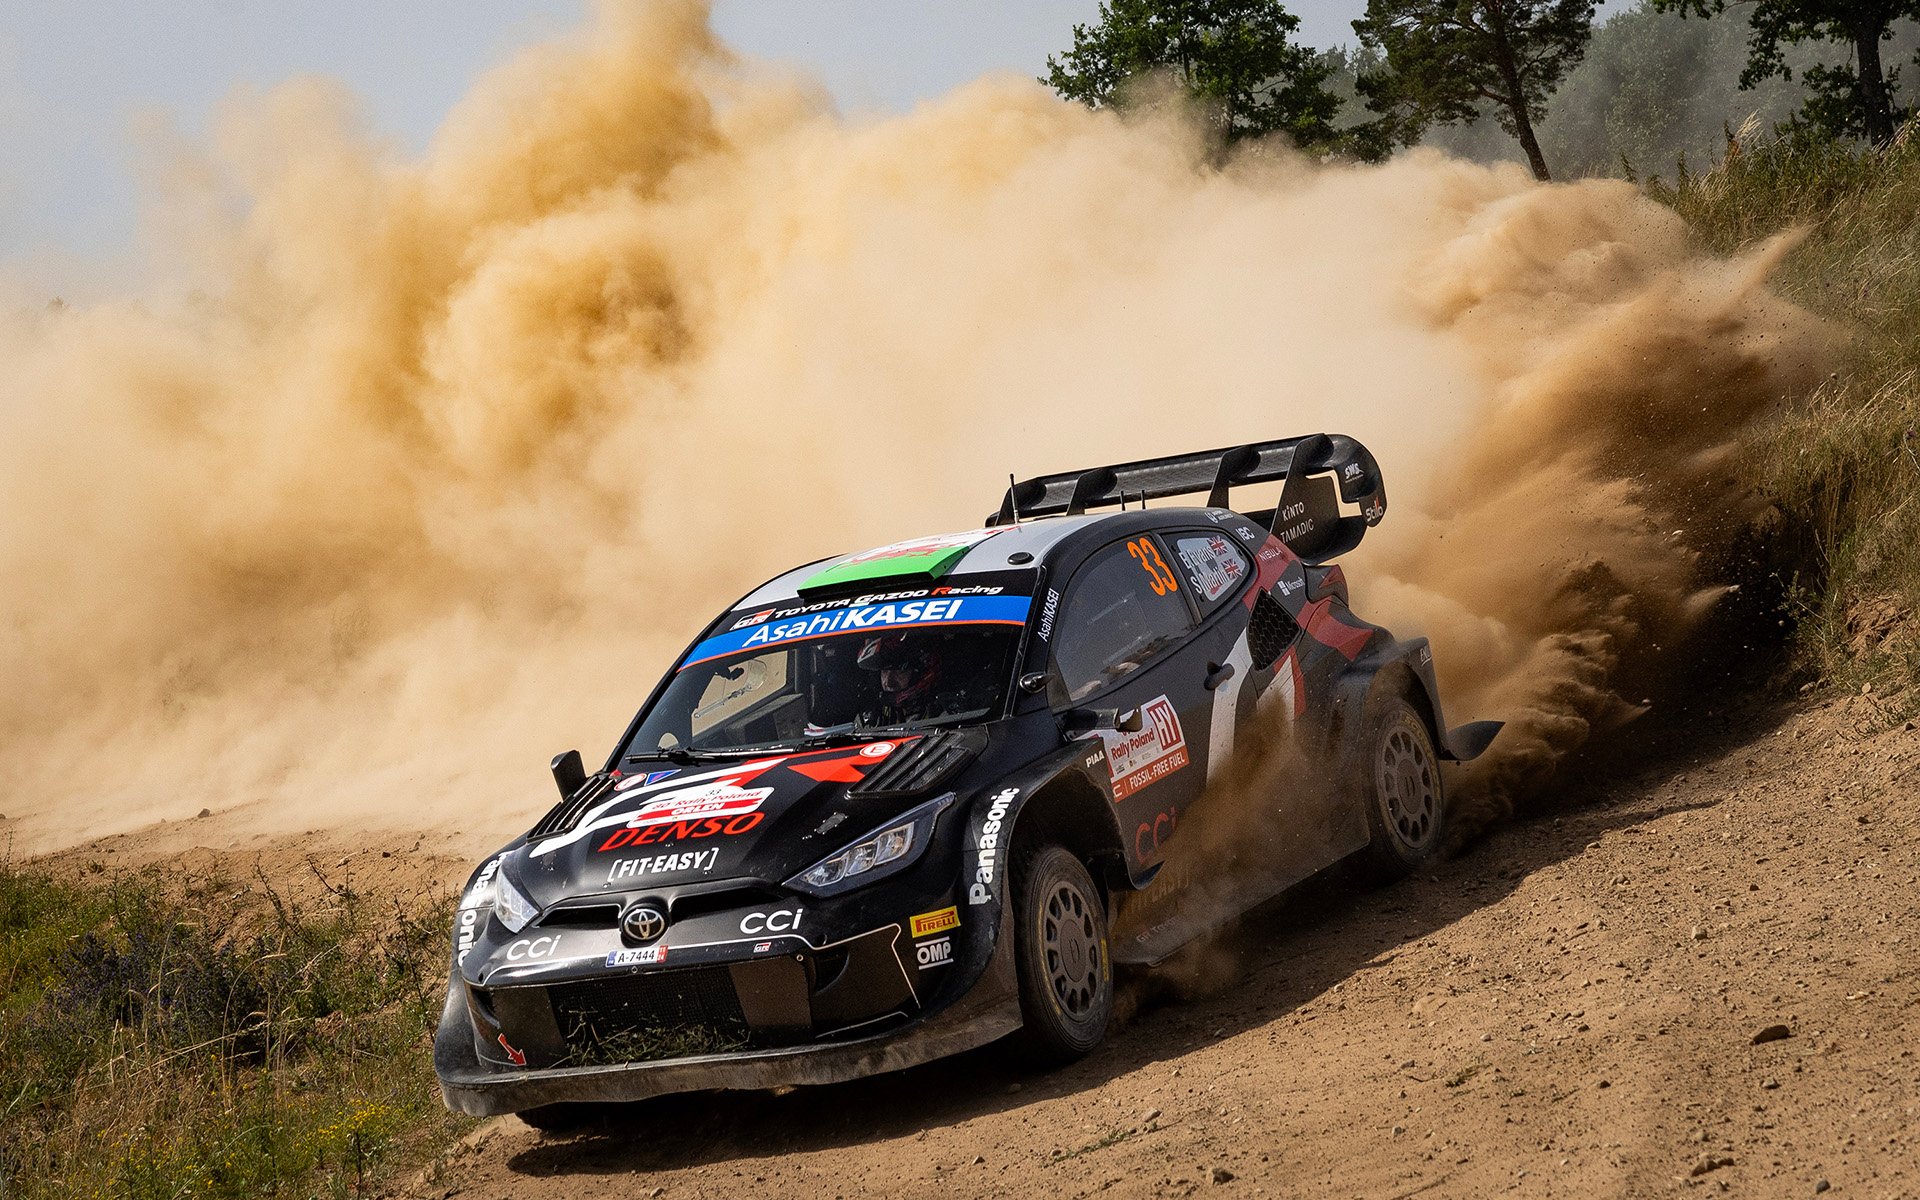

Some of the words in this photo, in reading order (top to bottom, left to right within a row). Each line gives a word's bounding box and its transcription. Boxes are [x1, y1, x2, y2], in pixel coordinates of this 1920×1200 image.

[1345, 463, 1360, 480] SWS
[1280, 519, 1315, 543] TAMADIC
[1127, 537, 1178, 596] 33
[774, 599, 850, 619] TOYOTA
[851, 589, 929, 608] GAZOO
[930, 586, 1004, 596] Racing
[1038, 588, 1060, 643] AsahiKASEI
[742, 599, 964, 648] AsahiKASEI
[1149, 704, 1177, 747] HY
[1111, 742, 1130, 761] Rally
[1129, 728, 1155, 751] Poland
[1086, 750, 1105, 768] PIAA
[1129, 760, 1169, 790] FOSSIL-FREE
[1169, 752, 1186, 769] FUEL
[705, 789, 722, 797] 33
[713, 790, 763, 801] Poland
[671, 803, 725, 816] ORLEN
[598, 812, 766, 852] DENSO
[969, 787, 1020, 906] Panasonic
[916, 910, 956, 933] PIRELLI
[617, 950, 655, 963] A-7444
[916, 942, 951, 964] OMP
